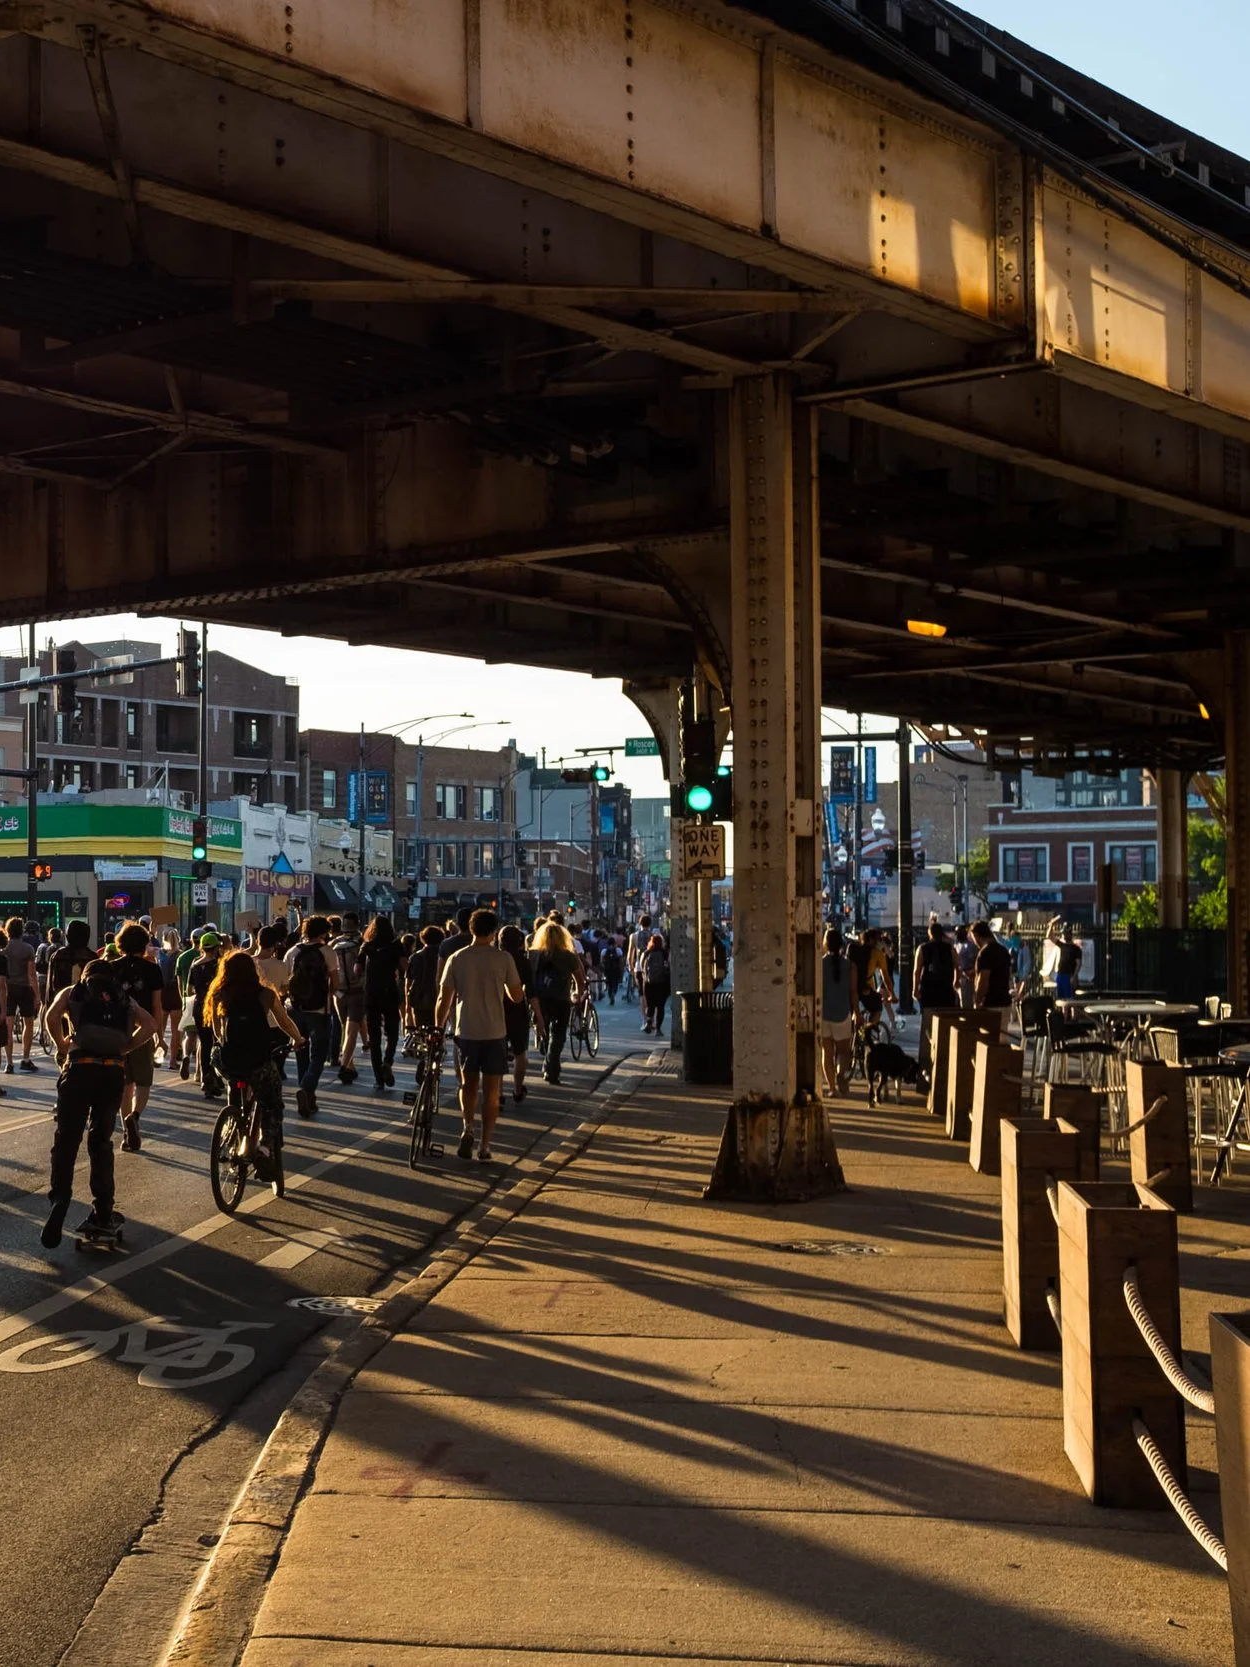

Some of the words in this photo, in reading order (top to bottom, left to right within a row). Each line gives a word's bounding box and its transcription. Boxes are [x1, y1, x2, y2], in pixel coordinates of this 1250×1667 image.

[688, 829, 719, 842] ONE
[688, 844, 719, 857] WAY
[246, 869, 278, 889] PICK
[295, 874, 310, 889] UP
